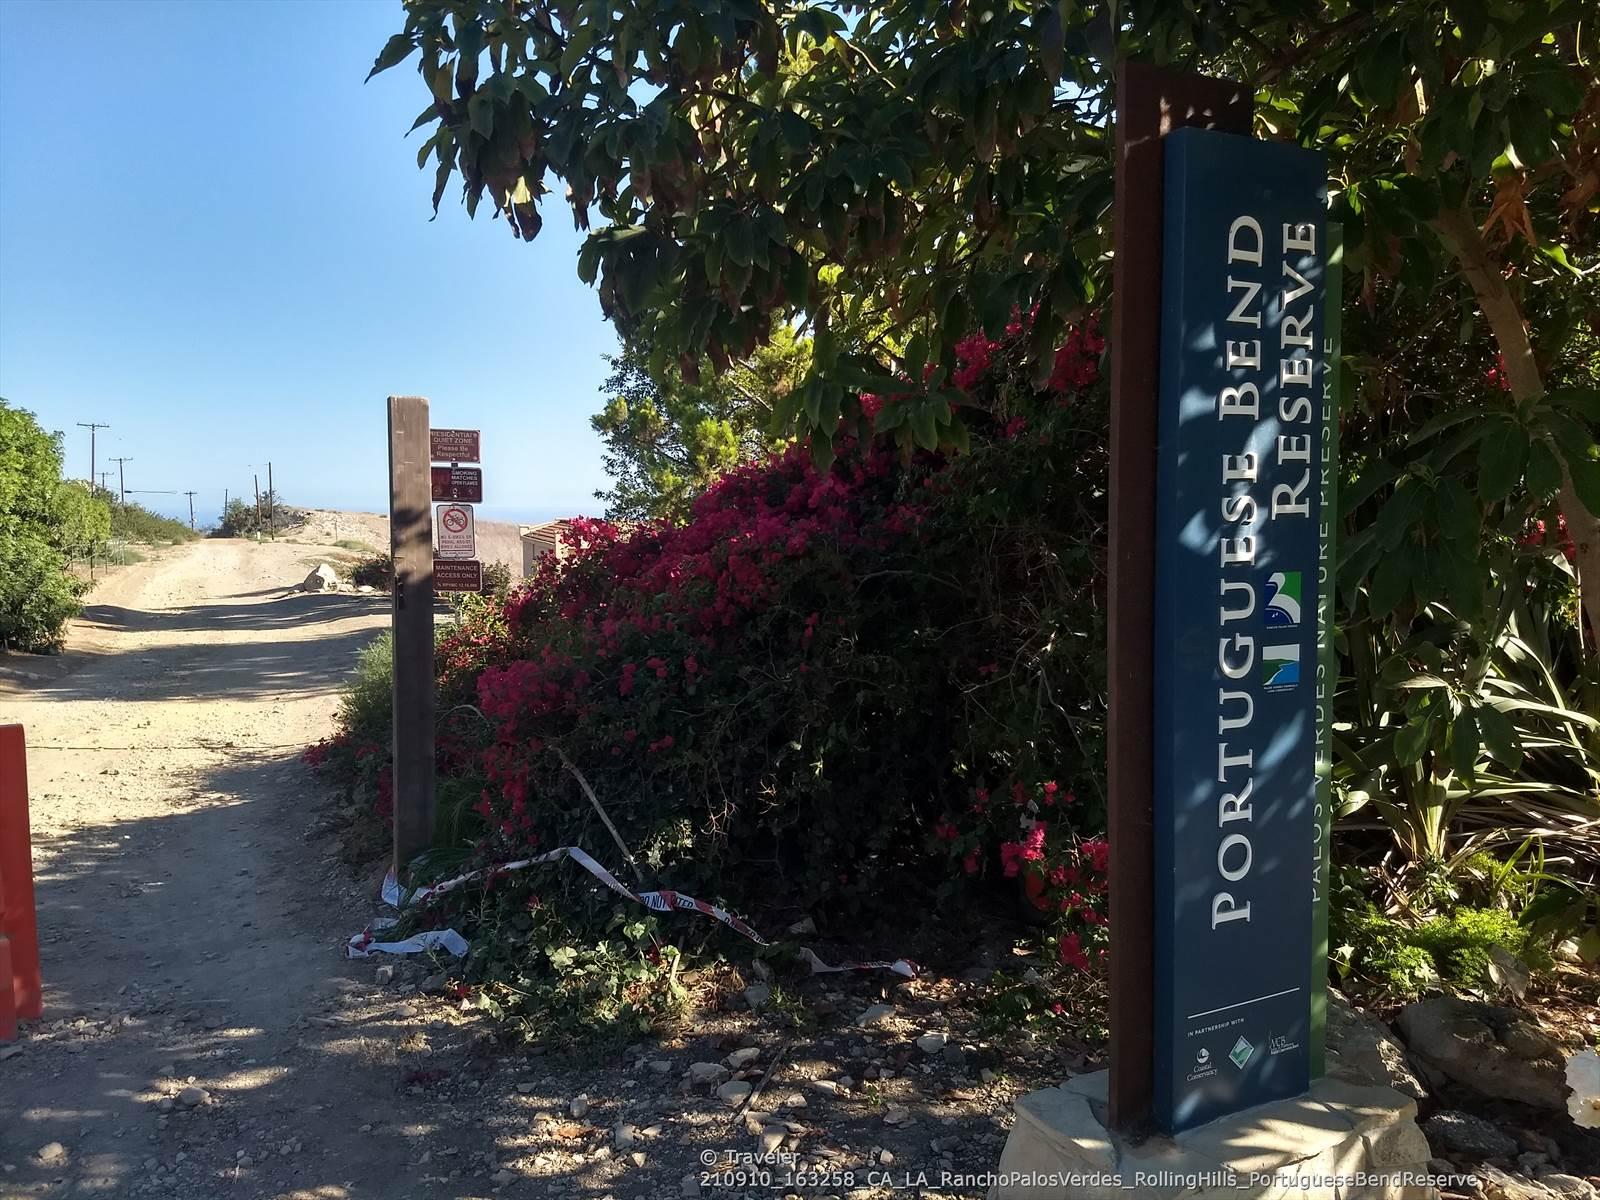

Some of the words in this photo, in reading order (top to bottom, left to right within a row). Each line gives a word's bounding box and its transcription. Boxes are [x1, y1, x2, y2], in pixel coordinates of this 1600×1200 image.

[1218, 215, 1264, 421] BEND
[1271, 222, 1316, 521] RESERVE
[1212, 451, 1258, 930] PORTUGUESE
[1186, 1068, 1218, 1082] Conservancy
[1193, 1061, 1212, 1073] Coastal
[1195, 1021, 1230, 1036] PARTNERSHIP
[1230, 1018, 1245, 1026] WITH
